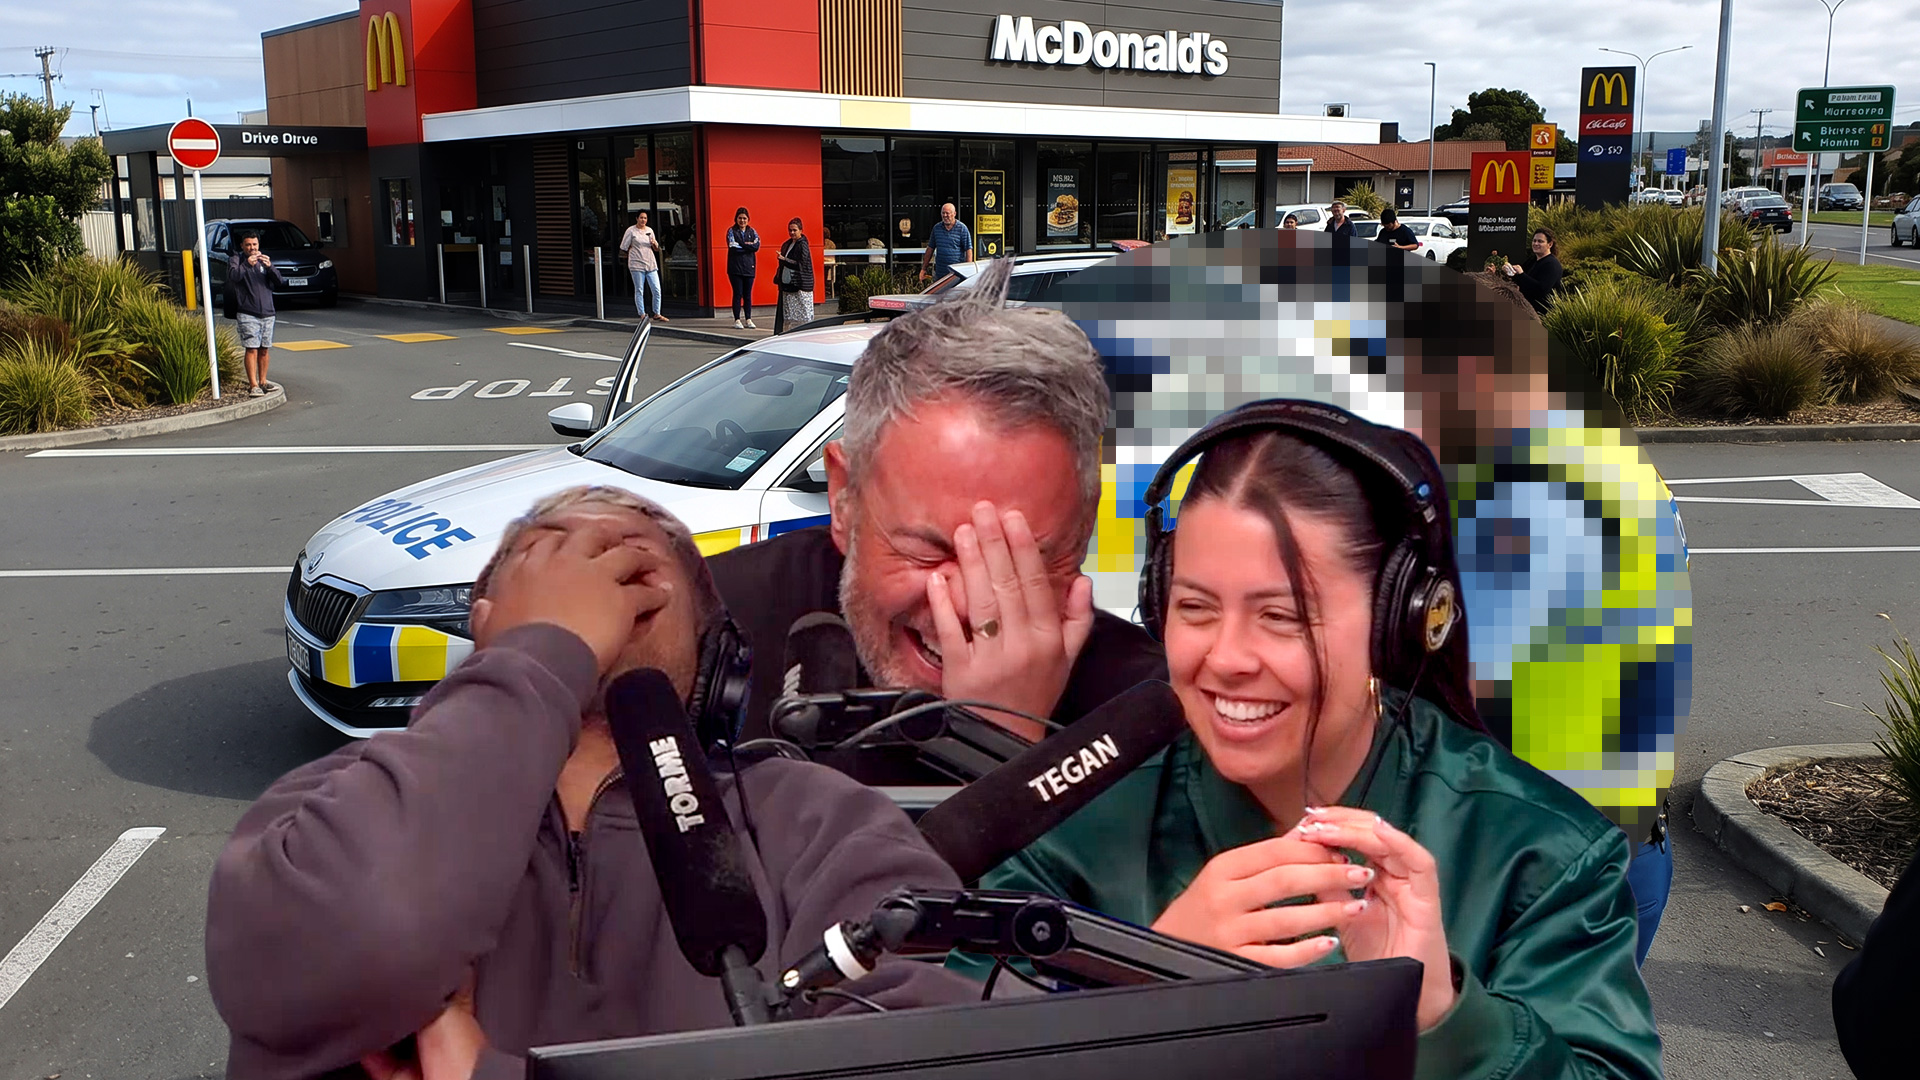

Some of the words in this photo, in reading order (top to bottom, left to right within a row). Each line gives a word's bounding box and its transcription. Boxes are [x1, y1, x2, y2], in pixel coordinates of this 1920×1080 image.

[990, 14, 1229, 76] McDonald's
[242, 131, 279, 144] Drive
[341, 499, 476, 560] POLICE
[649, 736, 705, 833] TORME
[1028, 733, 1119, 802] TEGAN
